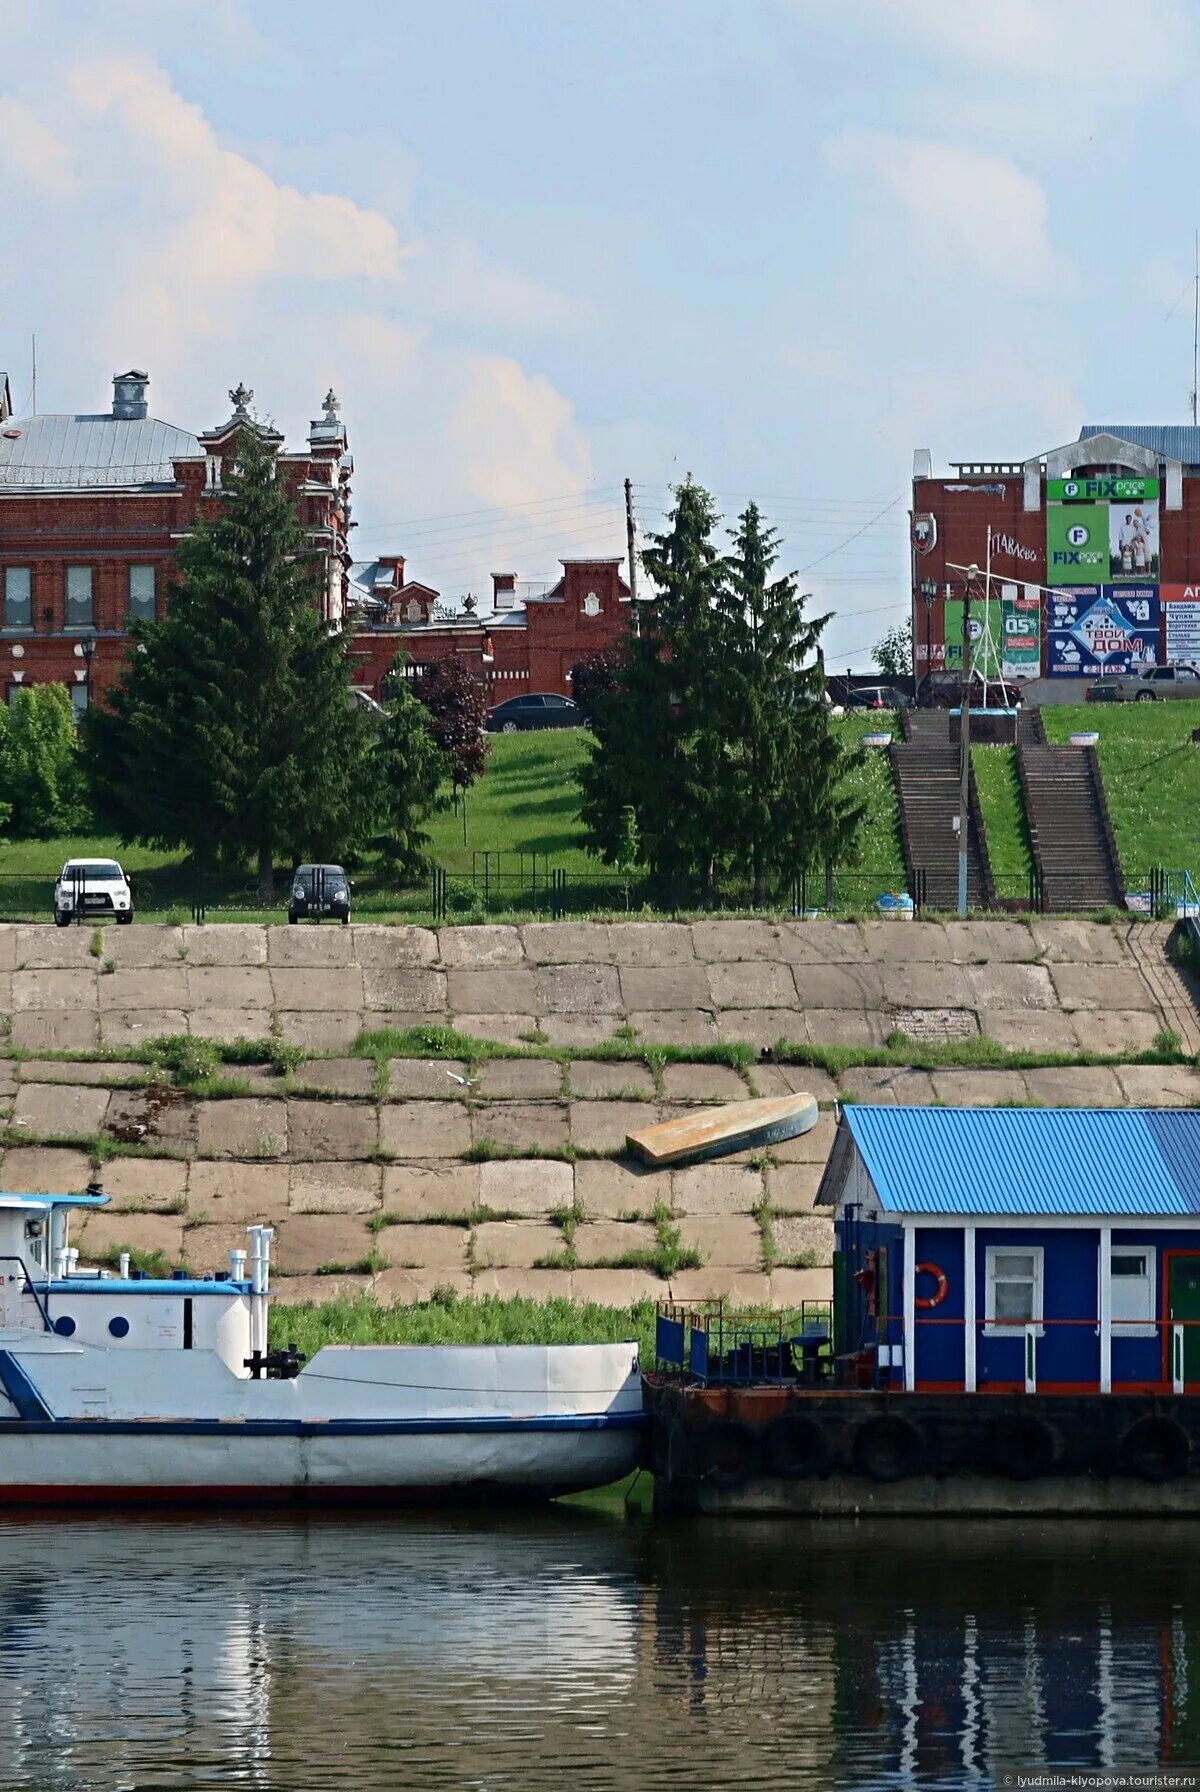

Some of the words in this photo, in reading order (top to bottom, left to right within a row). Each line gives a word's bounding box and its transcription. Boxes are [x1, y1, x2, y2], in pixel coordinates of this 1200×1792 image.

[1086, 481, 1117, 497] FIX
[1116, 481, 1145, 493] price
[1053, 552, 1080, 564] FIX
[1078, 551, 1104, 561] price
[1091, 637, 1144, 653] ДОМ
